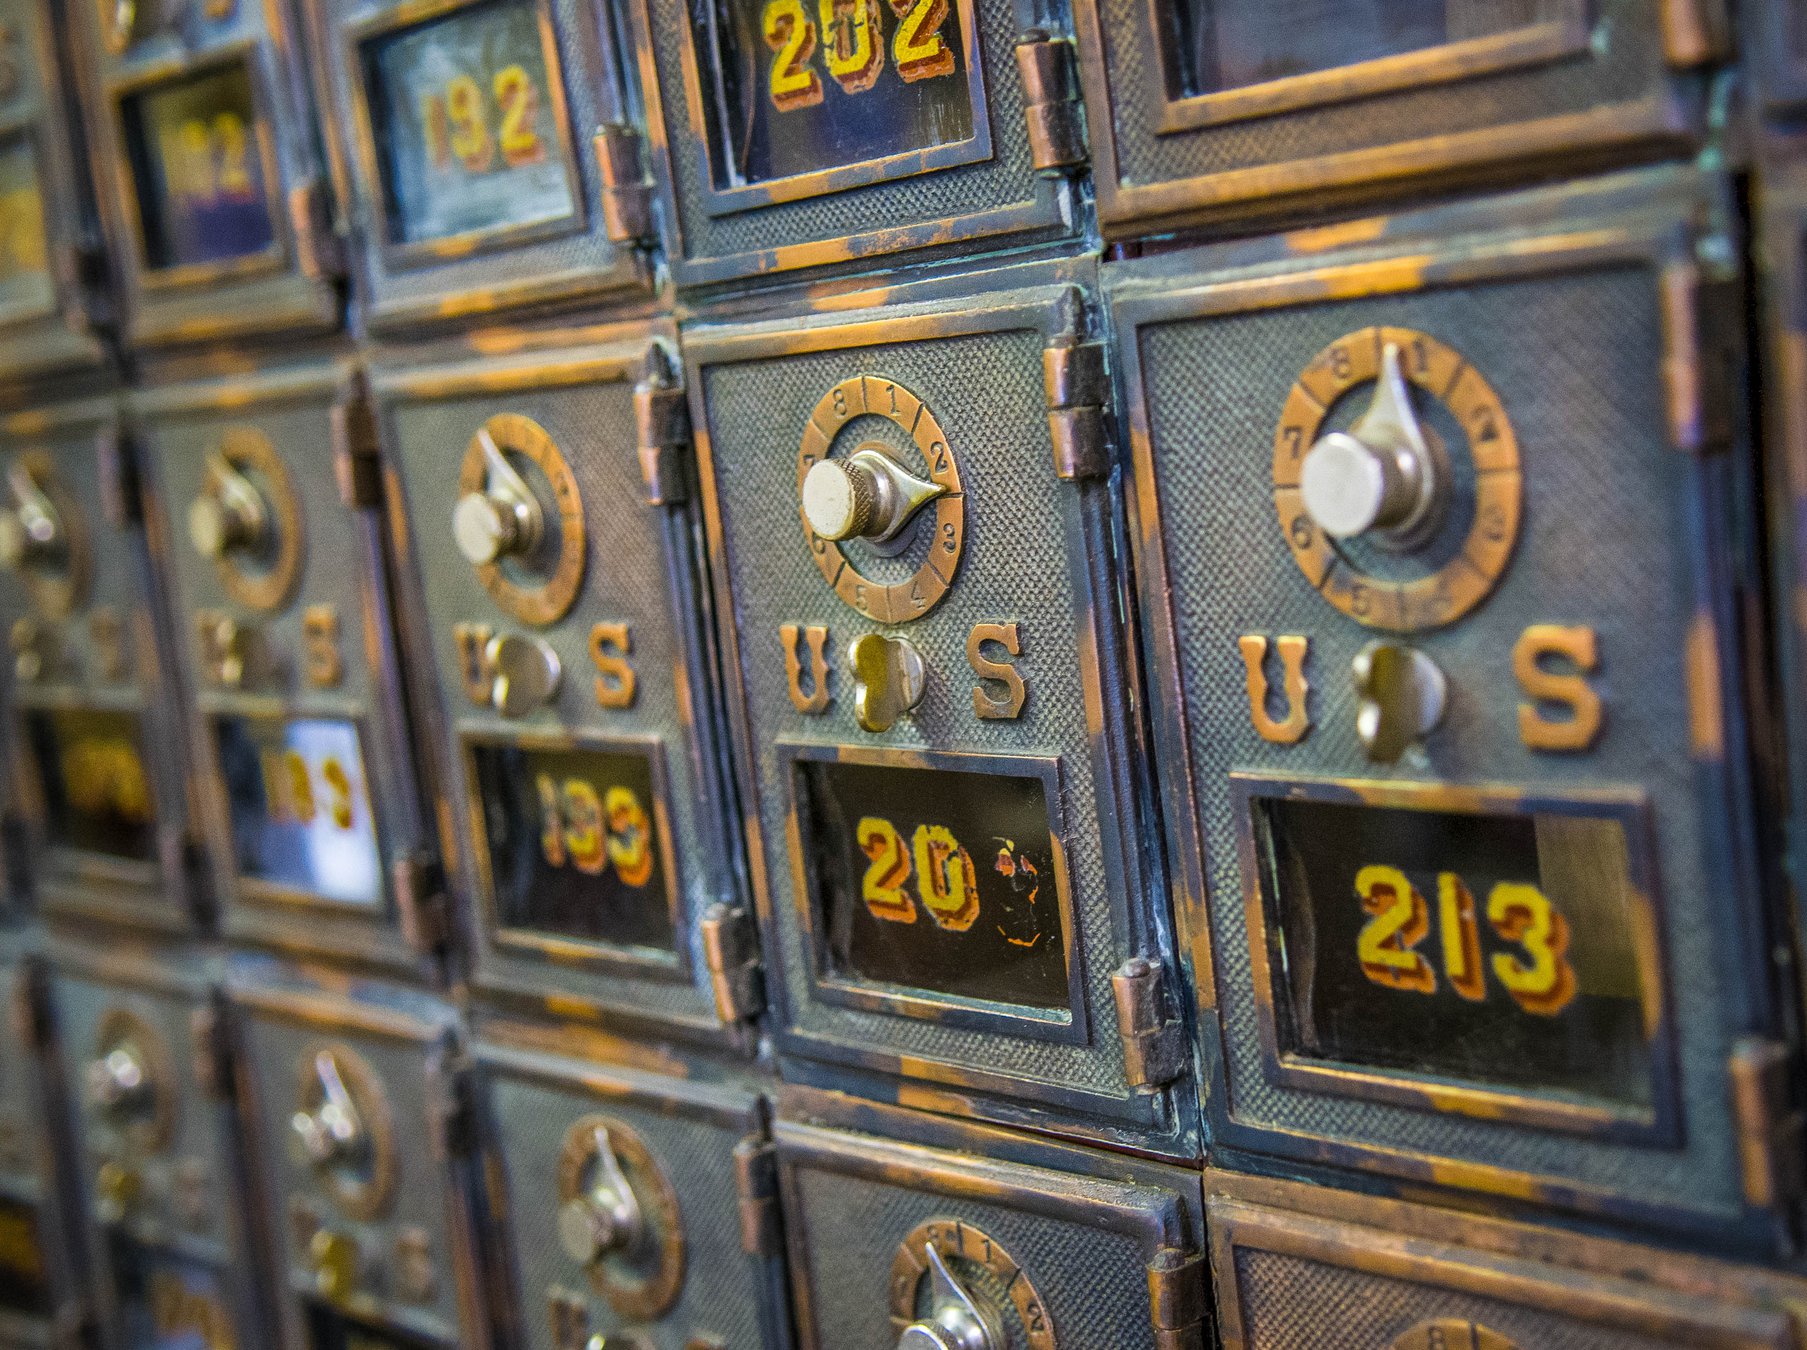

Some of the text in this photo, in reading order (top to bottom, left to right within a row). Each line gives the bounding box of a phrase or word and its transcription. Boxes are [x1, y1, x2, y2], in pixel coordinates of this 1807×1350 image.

[762, 0, 956, 113] 202
[419, 64, 547, 175] 192
[832, 387, 847, 419] 8
[884, 384, 901, 417] 1
[1282, 424, 1302, 459] 7
[929, 440, 949, 475] 2
[941, 522, 957, 554] 3
[1289, 517, 1313, 551] 6
[588, 620, 635, 708] S
[779, 622, 1026, 719] U S
[1238, 623, 1602, 751] U S
[856, 816, 1040, 947] 20
[1354, 864, 1578, 1017] 213
